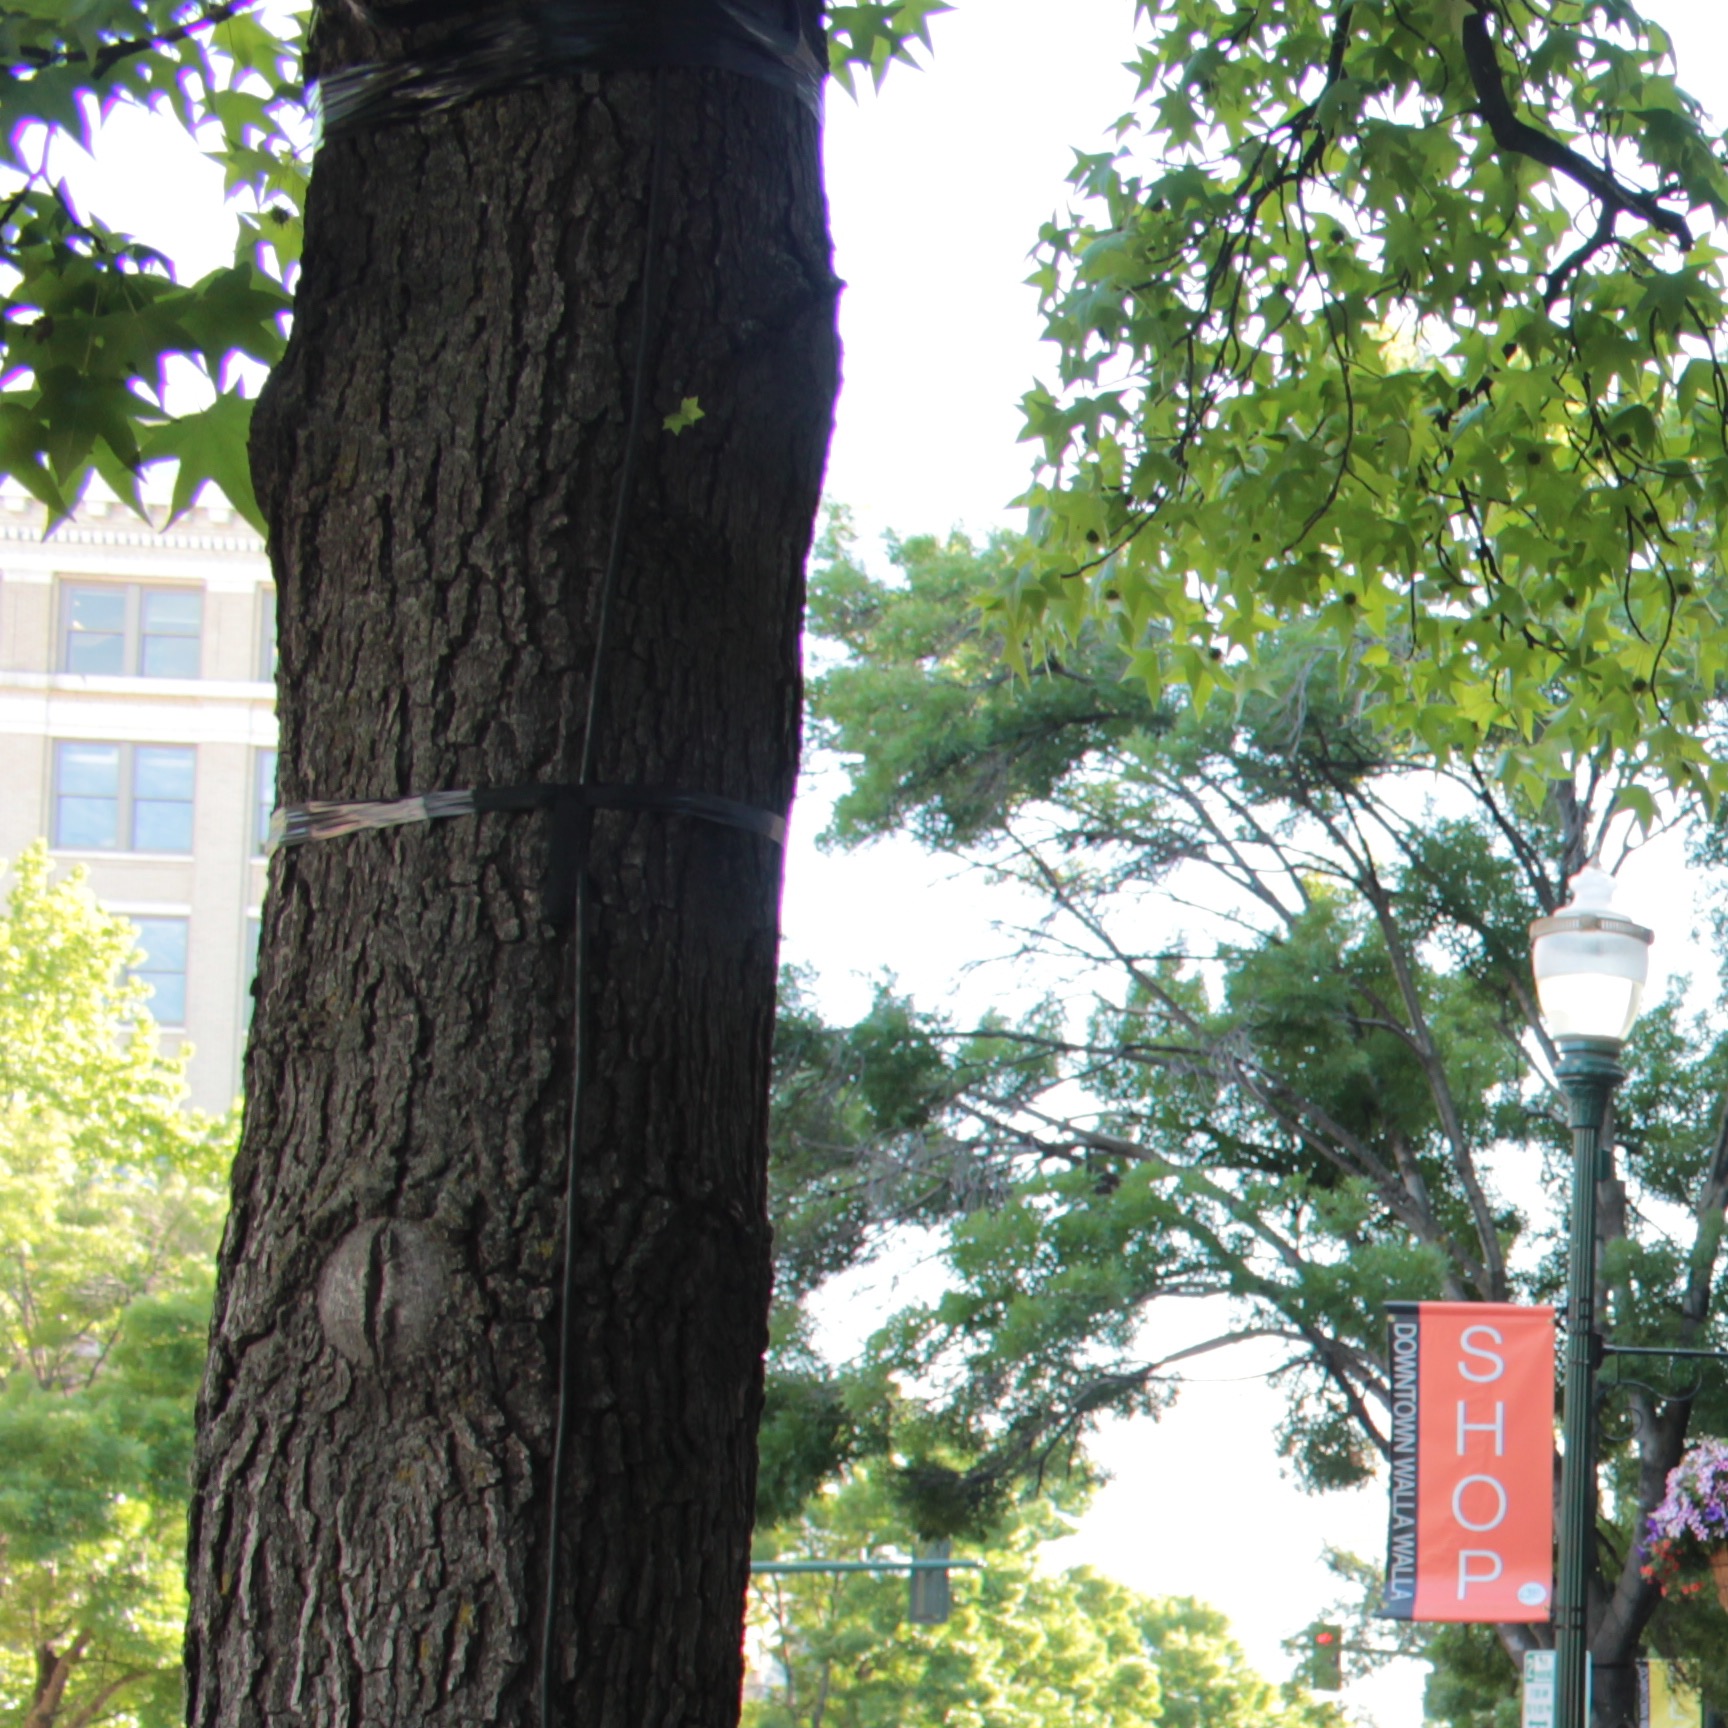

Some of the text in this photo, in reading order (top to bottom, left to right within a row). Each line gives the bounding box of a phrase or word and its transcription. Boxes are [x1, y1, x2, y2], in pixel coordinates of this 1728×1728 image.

[1390, 1322, 1417, 1602] DOWNTOWN WALLA WALLA
[1451, 1324, 1508, 1601] SHOP
